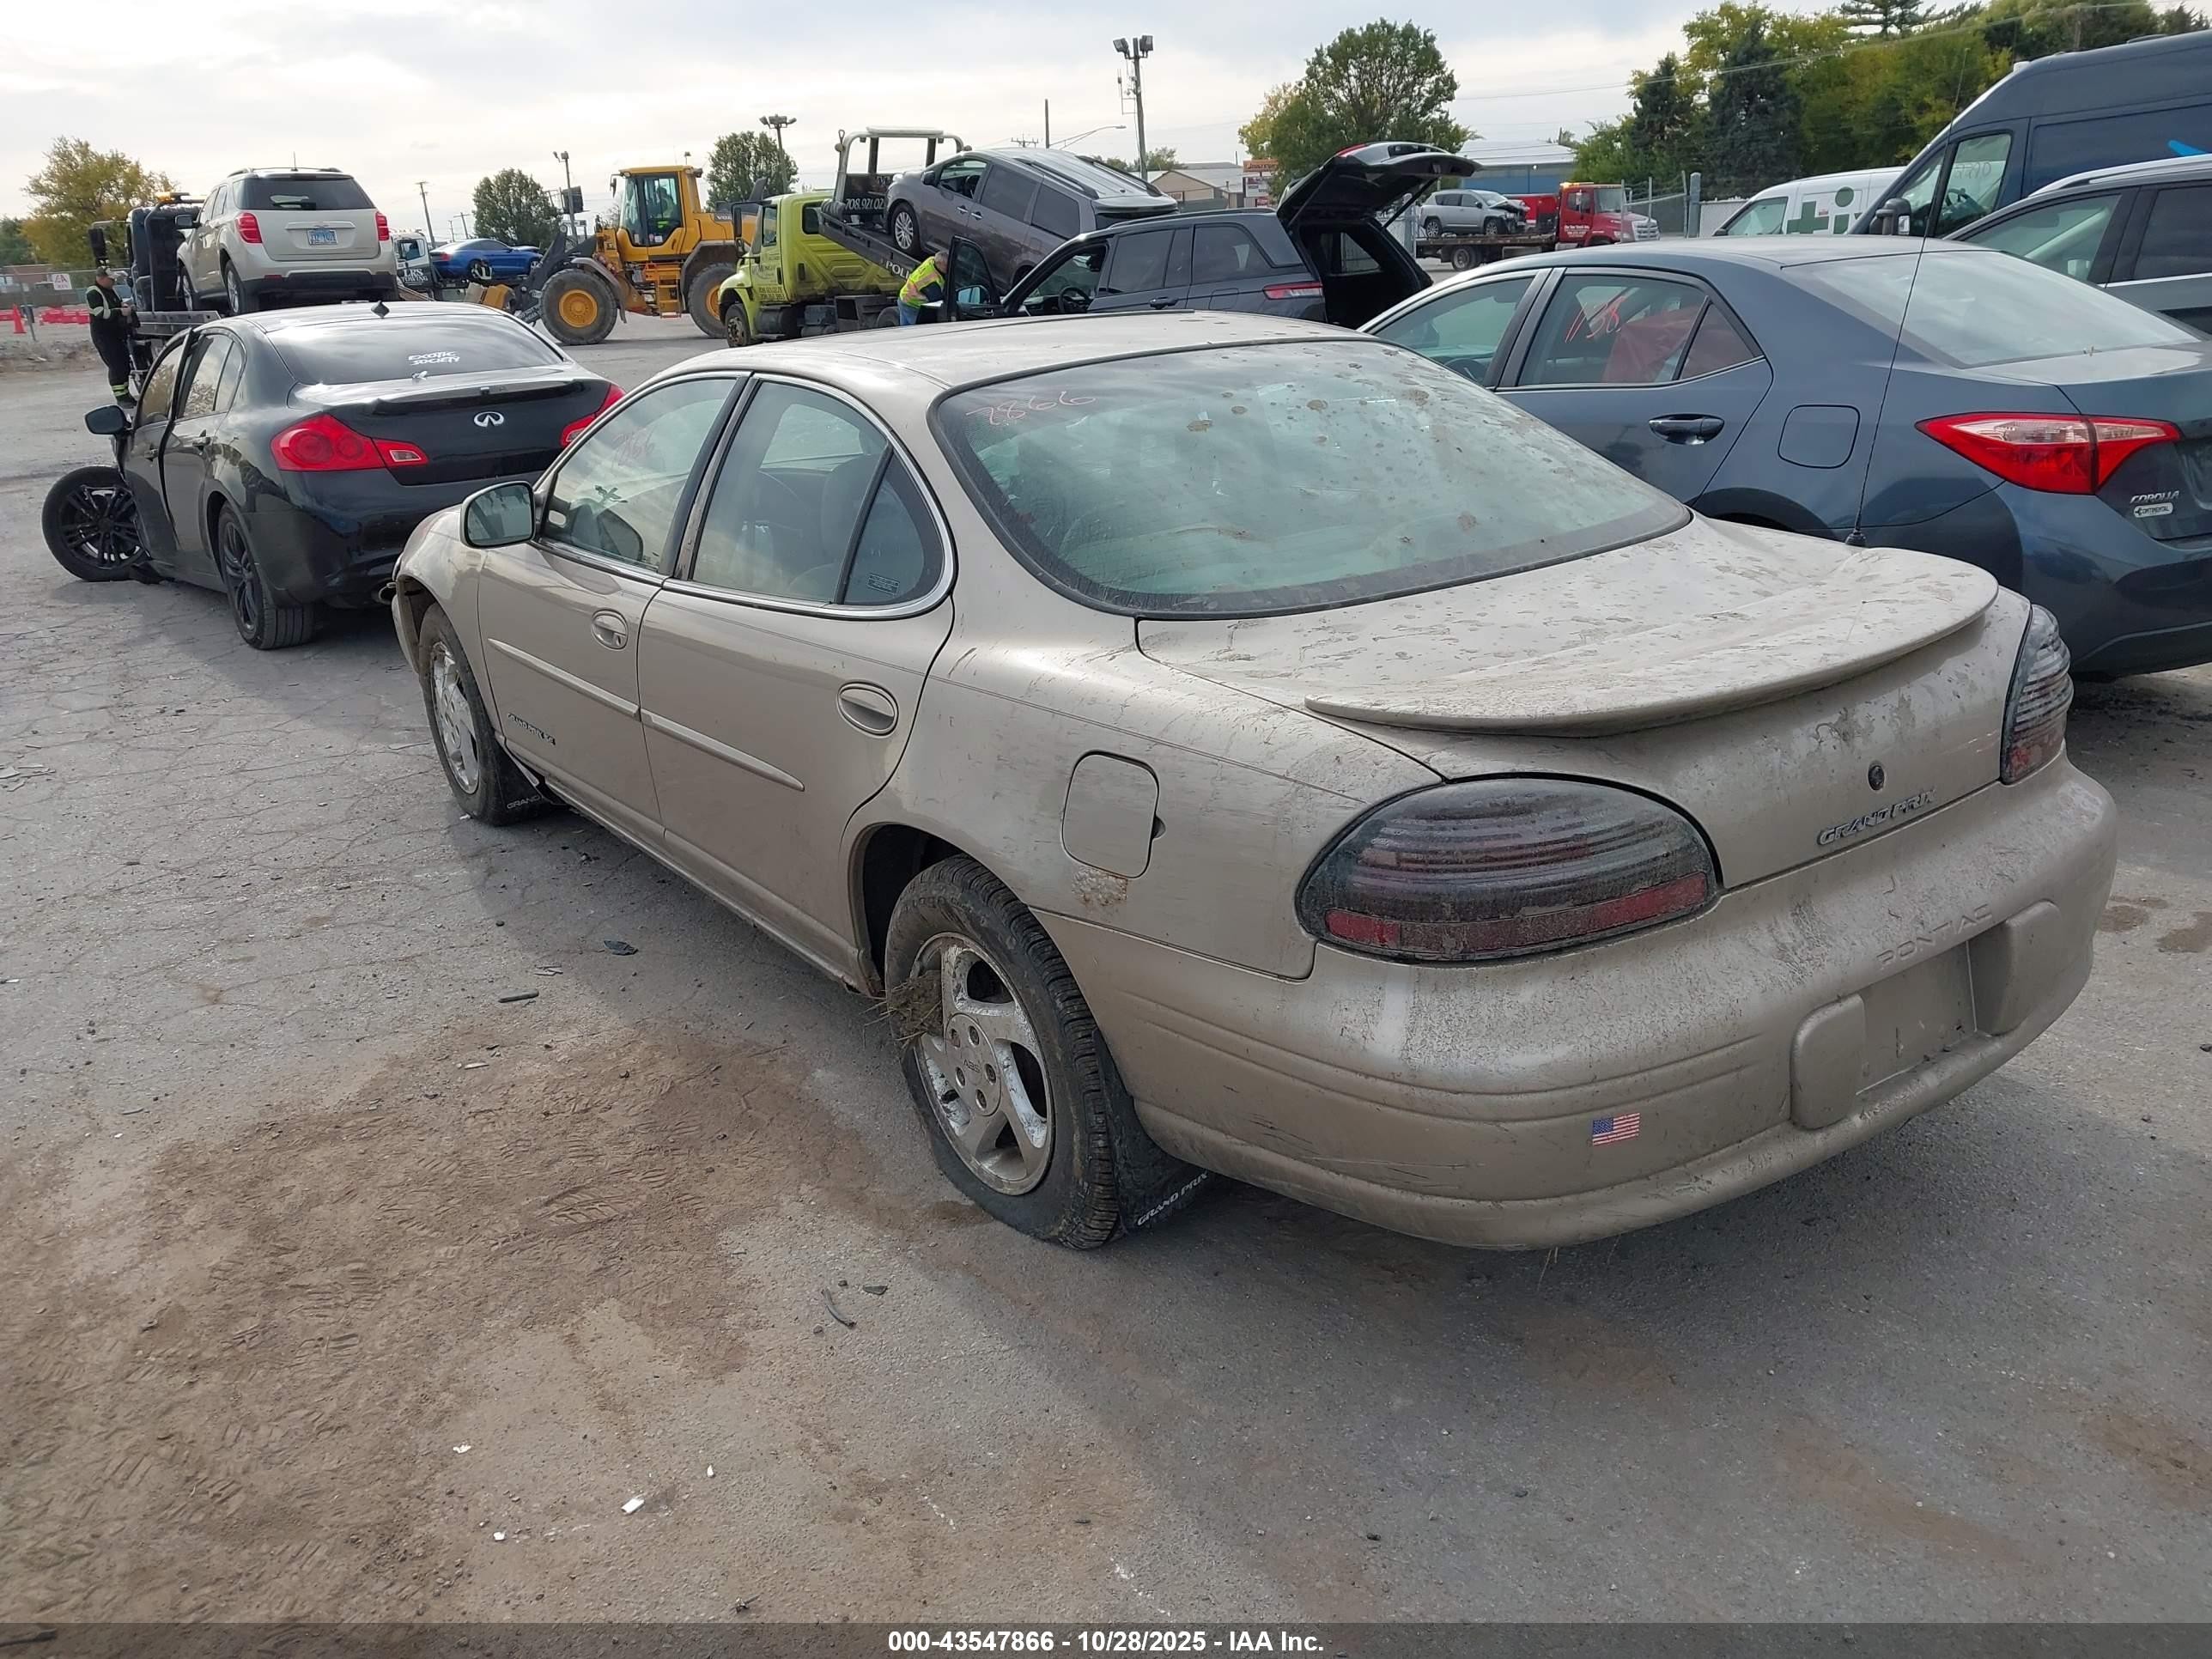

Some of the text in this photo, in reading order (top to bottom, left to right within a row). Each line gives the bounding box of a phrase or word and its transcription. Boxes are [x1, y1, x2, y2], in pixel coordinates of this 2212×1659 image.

[845, 198, 885, 210] 708.921.02
[885, 260, 909, 279] POLI
[401, 275, 428, 283] TOWING
[408, 351, 456, 361] EXOTIC
[410, 356, 460, 366] SOCIETY
[965, 391, 1097, 426] 7866
[2130, 489, 2180, 504] COROLLA
[507, 713, 529, 730] GRAND
[1818, 789, 1936, 845] GRAND PRIX
[1875, 902, 1993, 970] PONTIAC
[1137, 1192, 1179, 1226] GRAND
